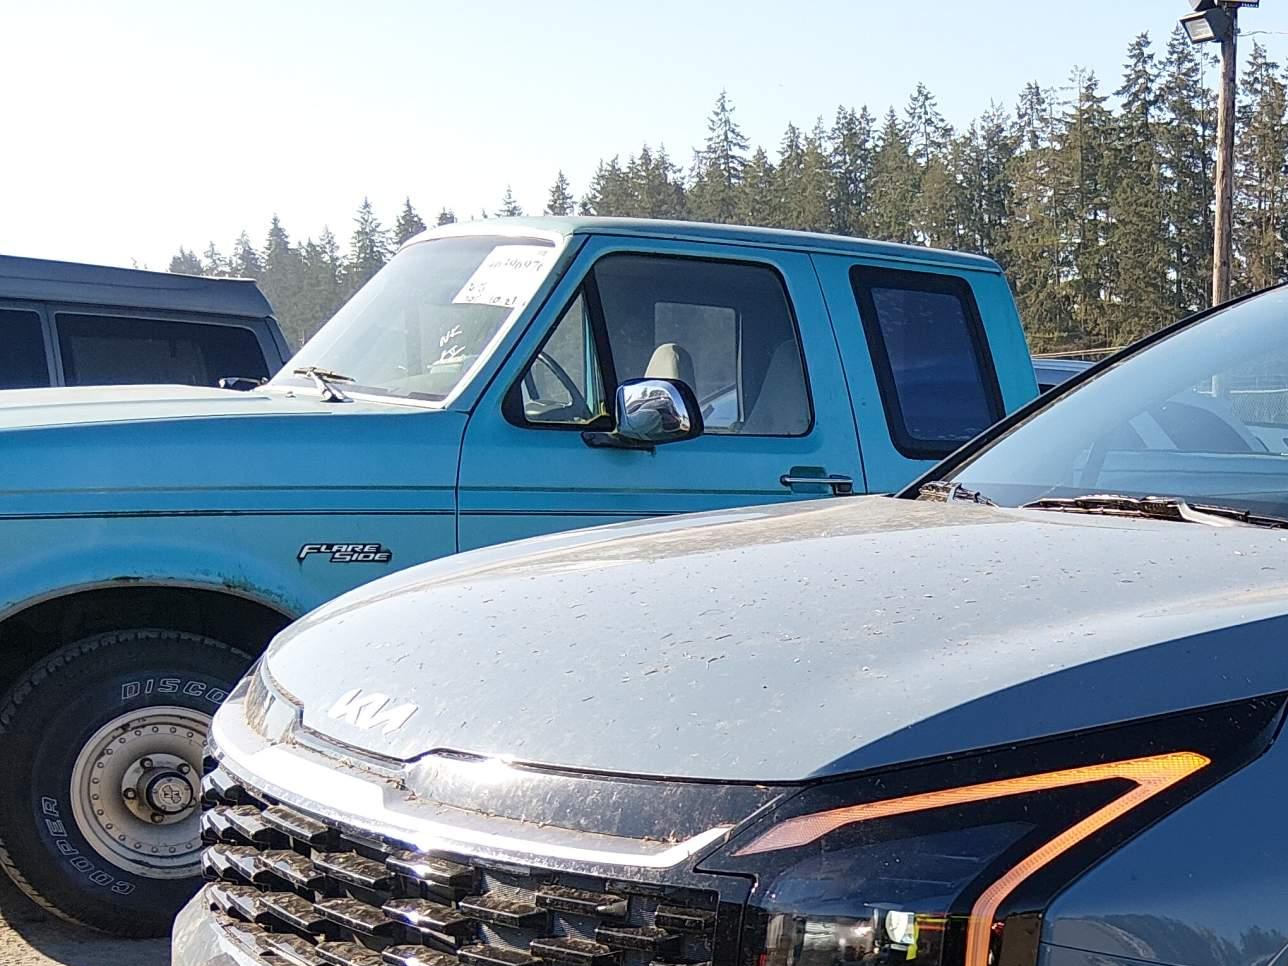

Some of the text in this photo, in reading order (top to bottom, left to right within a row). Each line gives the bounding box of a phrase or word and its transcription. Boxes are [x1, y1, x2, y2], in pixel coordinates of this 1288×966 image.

[299, 544, 379, 558] FLARE
[332, 552, 391, 562] SIDE
[41, 796, 136, 895] COOPER
